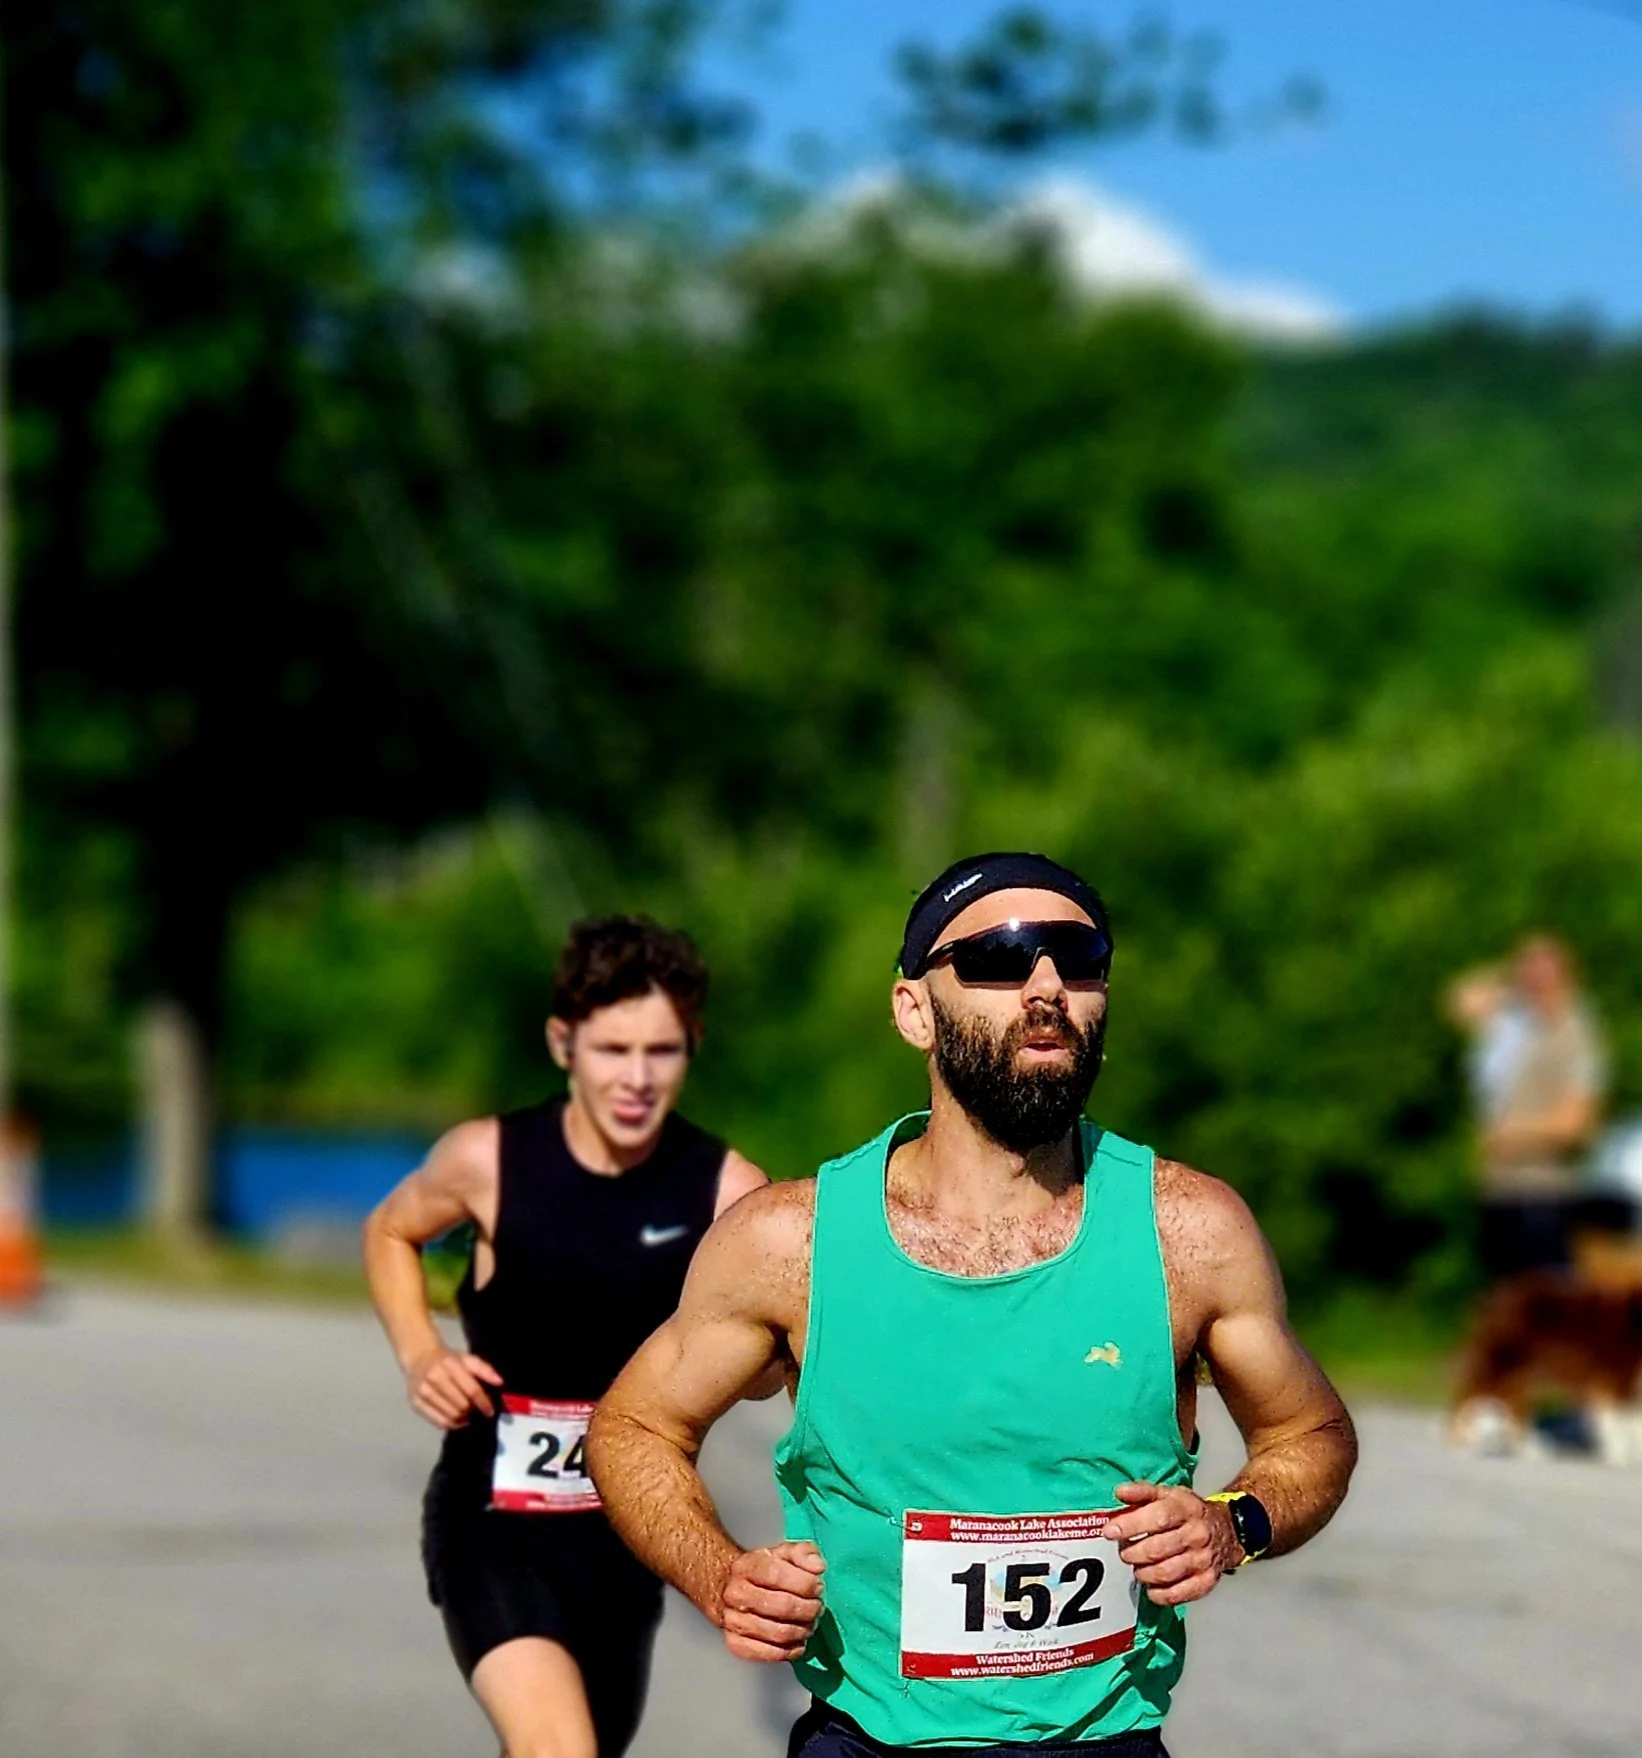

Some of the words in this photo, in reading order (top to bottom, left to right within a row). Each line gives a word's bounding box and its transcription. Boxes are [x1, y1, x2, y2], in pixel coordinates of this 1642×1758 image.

[950, 1518, 1019, 1531] Maranacook
[1020, 1519, 1046, 1530] Lake
[1047, 1516, 1110, 1529] Association
[951, 1558, 1105, 1632] 152
[950, 1653, 1094, 1676] www.watershedfriends.com
[976, 1652, 1034, 1665] Watershed
[1035, 1648, 1074, 1662] Friends
